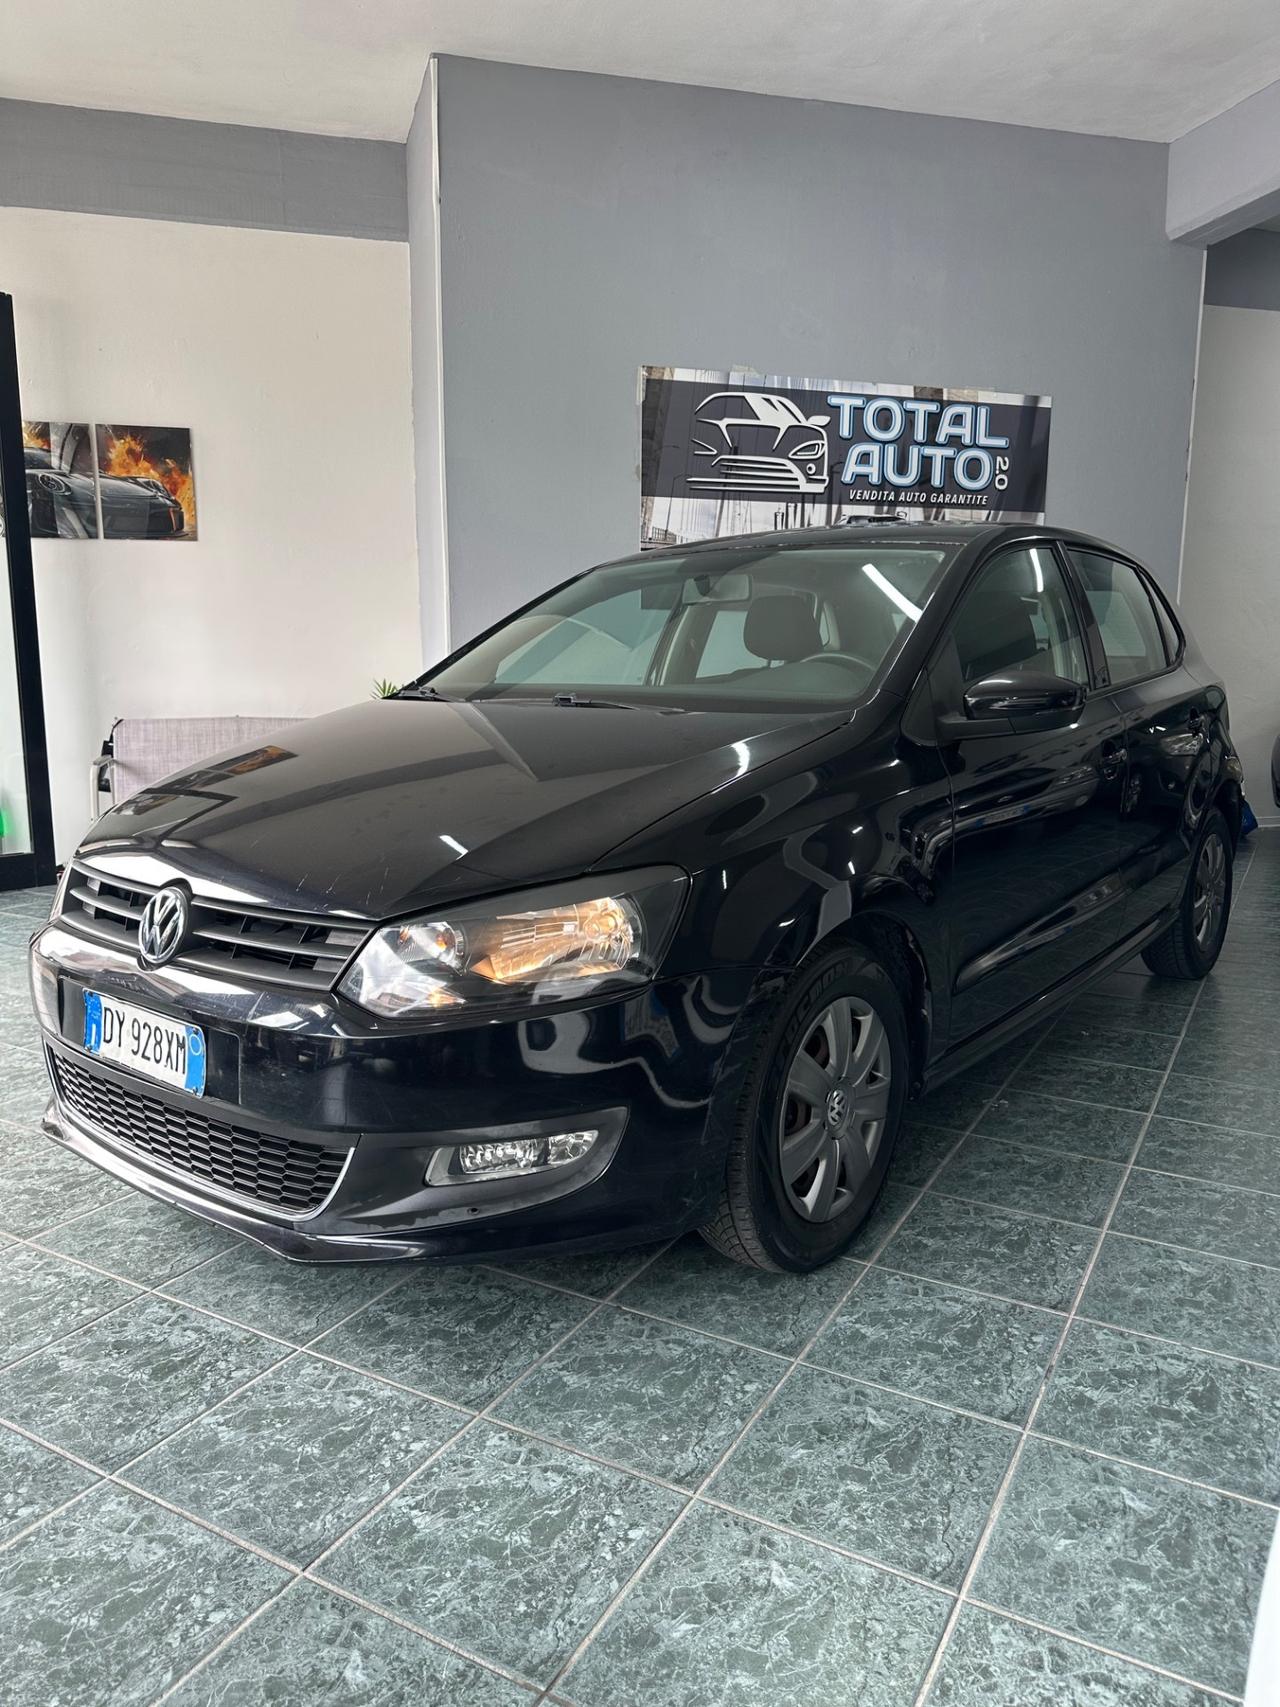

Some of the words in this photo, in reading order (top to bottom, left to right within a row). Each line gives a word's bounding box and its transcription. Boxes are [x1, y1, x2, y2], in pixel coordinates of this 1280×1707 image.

[827, 395, 1010, 448] TOTAL
[841, 442, 994, 491] AUTO
[995, 456, 1009, 490] 2.0
[849, 489, 895, 502] VENDITA
[899, 491, 927, 504] AUTO
[930, 494, 989, 506] GARANTITE
